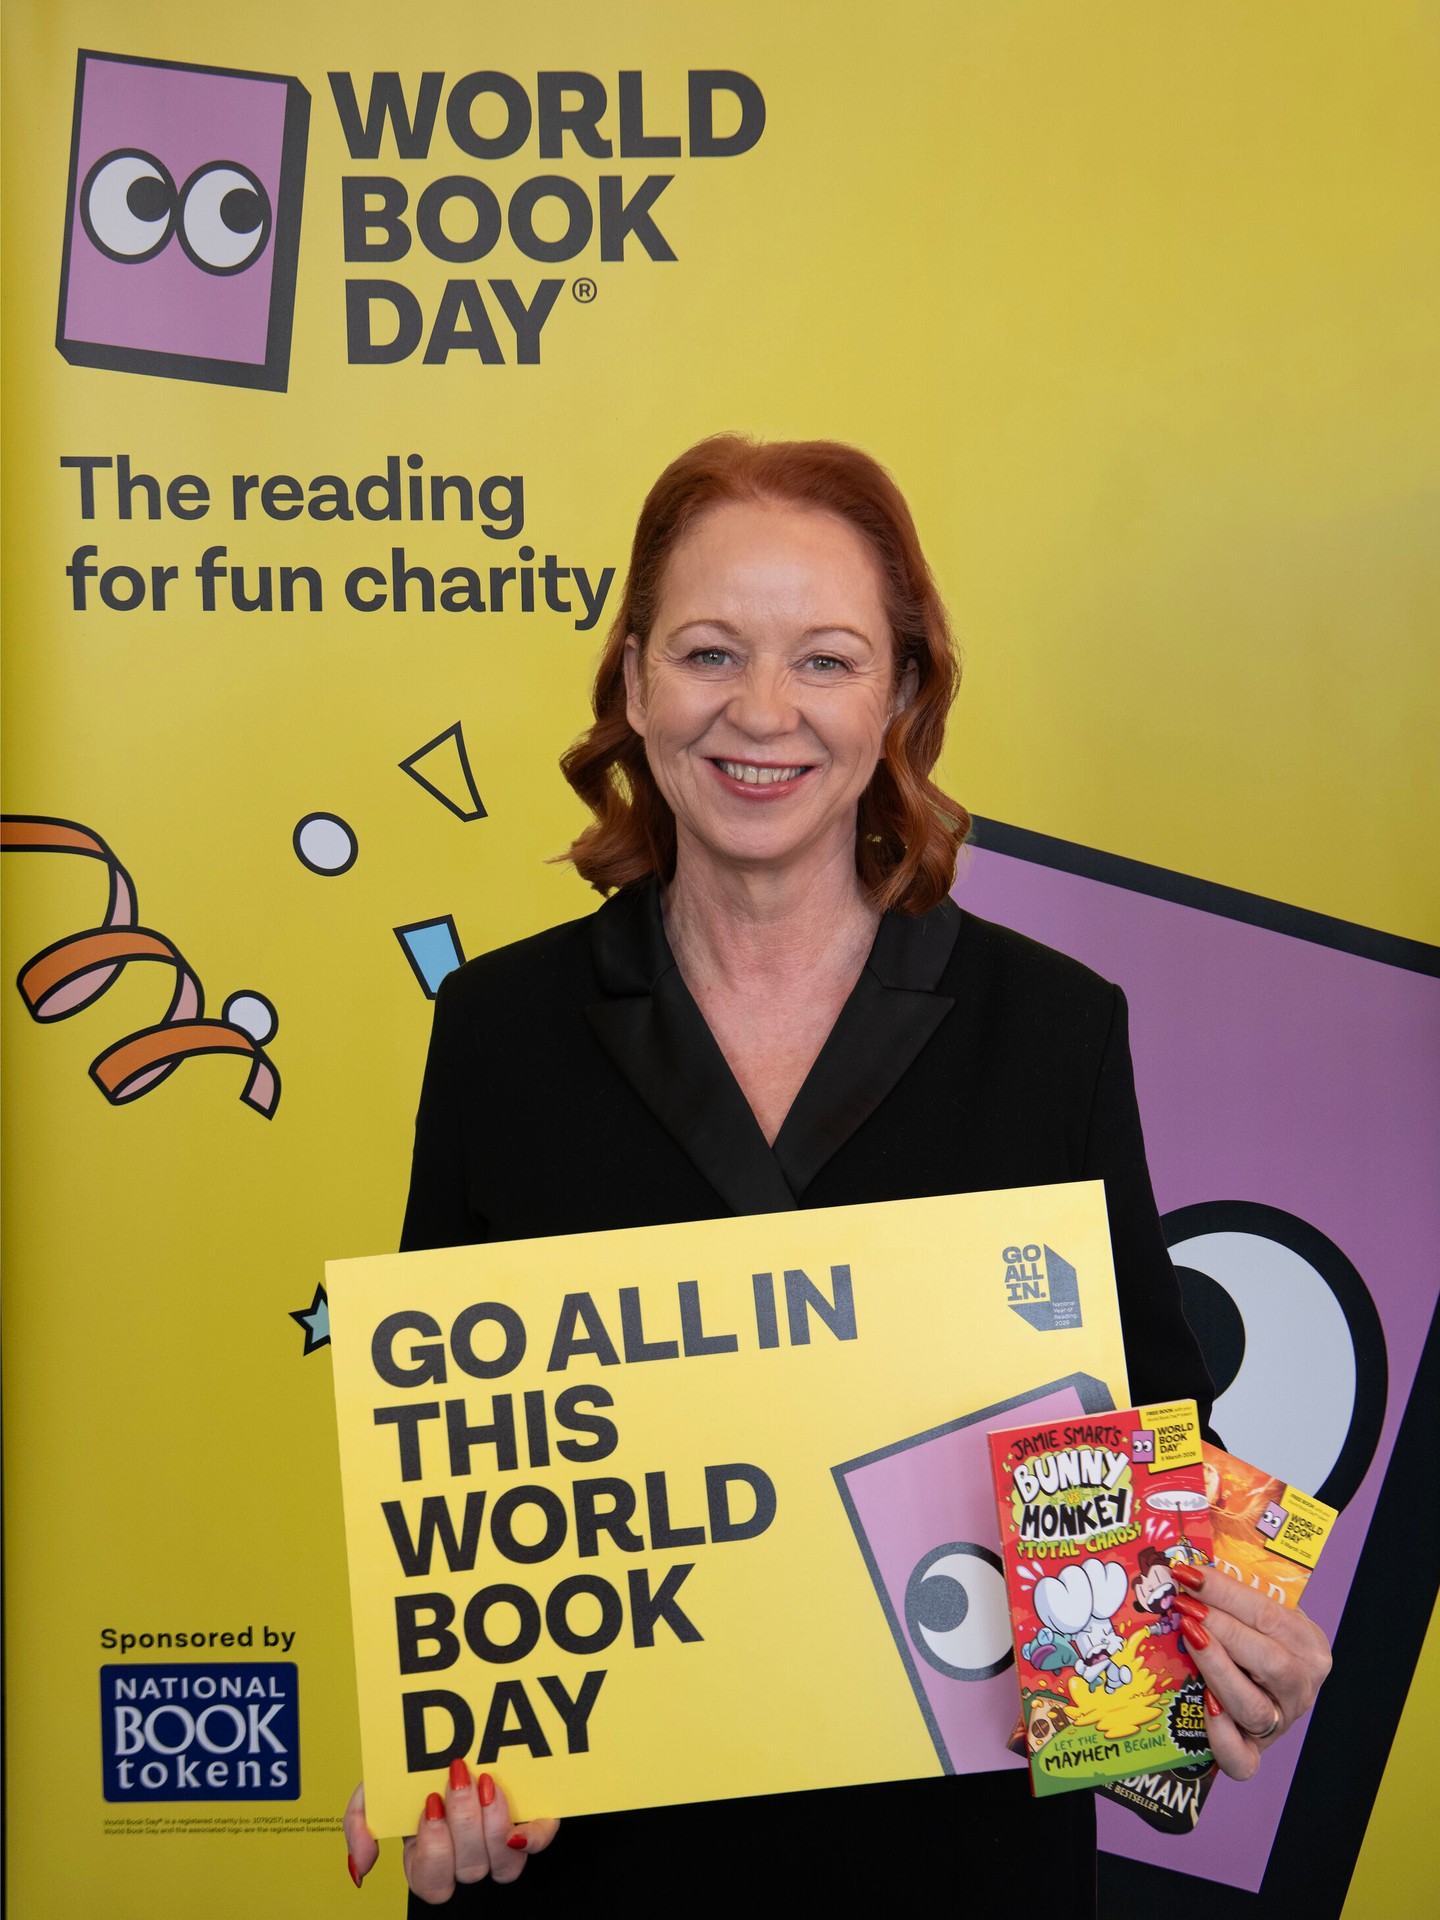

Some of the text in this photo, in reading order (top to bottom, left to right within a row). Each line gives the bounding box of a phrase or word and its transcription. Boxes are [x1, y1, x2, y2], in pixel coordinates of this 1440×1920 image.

[327, 69, 767, 160] WORLD
[341, 174, 679, 263] BOOK
[60, 452, 525, 540] The reading
[66, 545, 616, 631] for fun charity
[1002, 1244, 1042, 1264] GO
[1005, 1262, 1044, 1283] ALL
[1006, 1281, 1046, 1301] IN.
[370, 1264, 858, 1388] GO ALL IN
[373, 1385, 618, 1482] THIS
[1011, 1425, 1122, 1461] JAMIE SMART'S
[1157, 1422, 1194, 1435] WORLD
[1159, 1433, 1187, 1444] BOOK
[1012, 1449, 1130, 1504] BUNNY
[382, 1463, 777, 1577] WORLD
[1020, 1488, 1128, 1540] MONKEY
[1288, 1521, 1313, 1541] BOOK
[1291, 1513, 1323, 1536] WORLD
[1023, 1524, 1134, 1560] TOTAL CHAOS
[394, 1563, 704, 1675] BOOK
[101, 1625, 296, 1654] Sponsored by
[115, 1676, 286, 1700] NATIONAL
[1185, 1695, 1203, 1703] THE
[402, 1670, 608, 1773] DAY
[1175, 1717, 1208, 1730] SELLI
[1180, 1702, 1206, 1718] BES
[113, 1704, 288, 1756] BOOK
[1054, 1734, 1099, 1752] LET THE
[1045, 1734, 1167, 1771] MAYHEM BEGIN!
[116, 1754, 288, 1789] tokens
[1114, 1784, 1160, 1813] BESTSELLER
